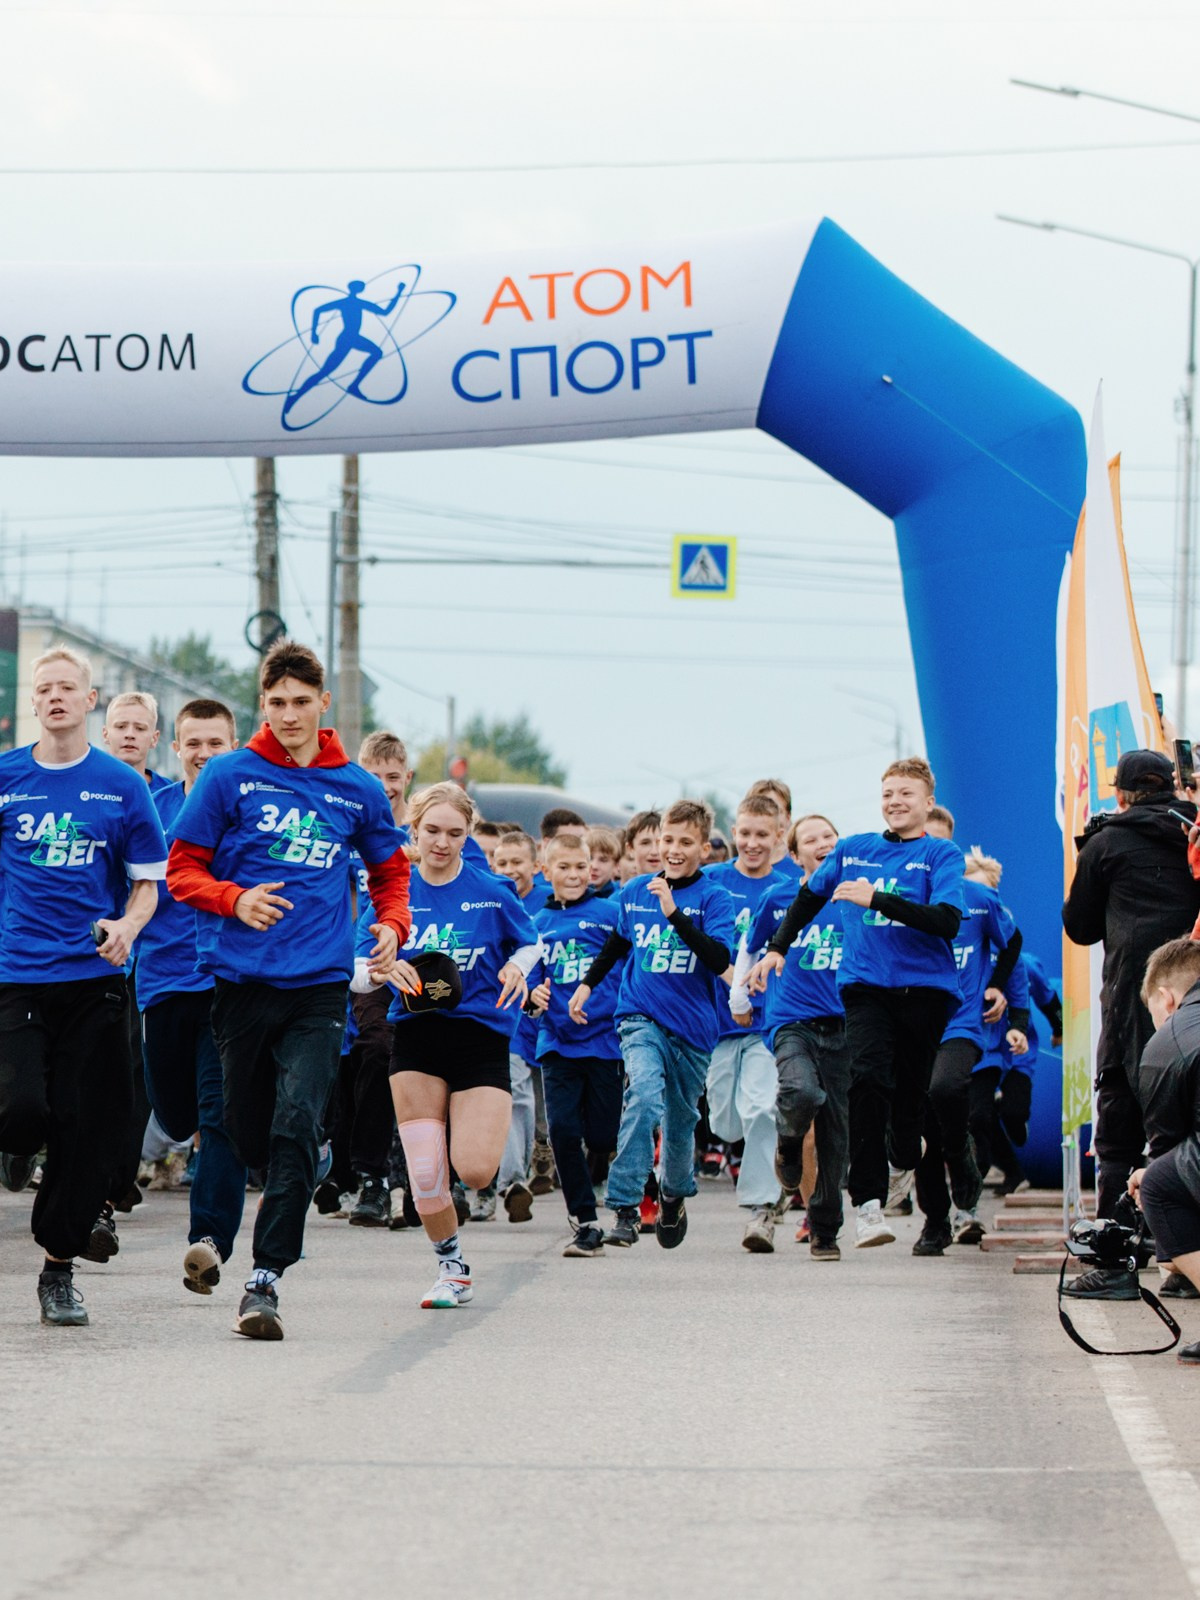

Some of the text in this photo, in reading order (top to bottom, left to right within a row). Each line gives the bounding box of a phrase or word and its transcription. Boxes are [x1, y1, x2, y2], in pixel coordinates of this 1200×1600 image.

[482, 260, 693, 326] АТОМ
[451, 329, 713, 404] СПОРТ
[90, 792, 123, 802] РОСАТОМ
[15, 812, 73, 842] ЗА!
[256, 804, 317, 837] ЗА!
[45, 839, 107, 867] БЕГ
[633, 922, 675, 949] ЗА!
